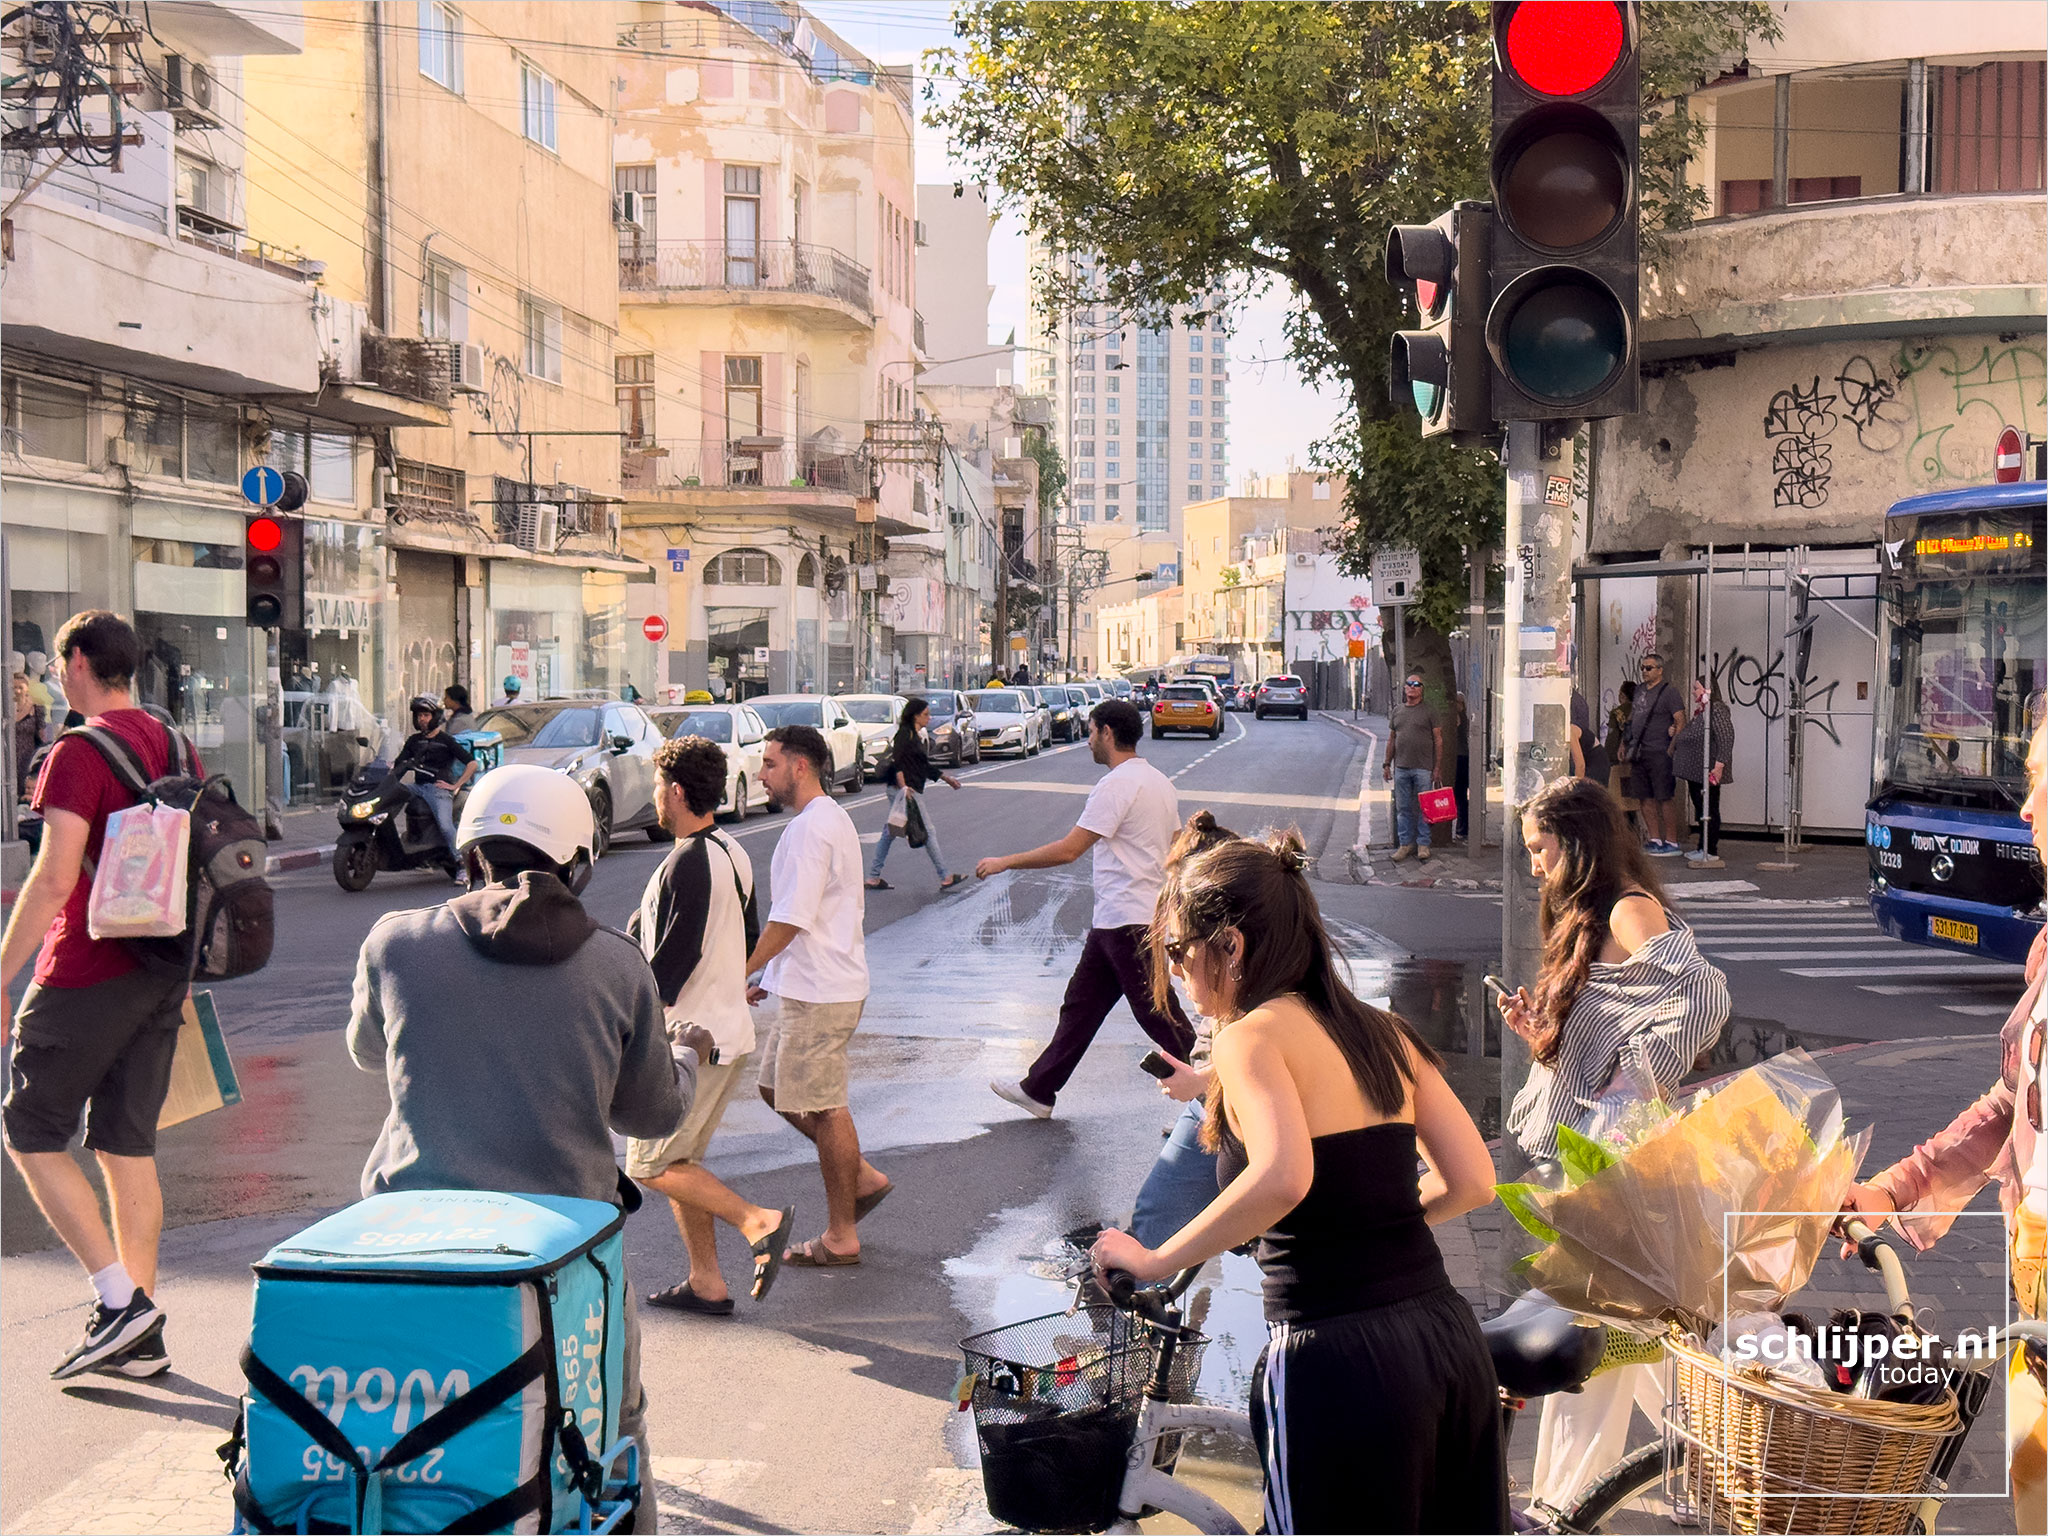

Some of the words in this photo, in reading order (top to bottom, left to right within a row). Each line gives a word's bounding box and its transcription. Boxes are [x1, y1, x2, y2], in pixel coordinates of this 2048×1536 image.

[1547, 480, 1570, 493] FCK
[1545, 490, 1569, 503] HMS
[503, 815, 512, 823] A
[1911, 832, 1935, 851] חשמלי
[1950, 837, 1980, 855] אוטובוס
[1879, 851, 1902, 869] 12328
[1996, 843, 2040, 862] HIGER
[352, 1227, 498, 1247] 221855
[289, 1364, 470, 1434] Wolt
